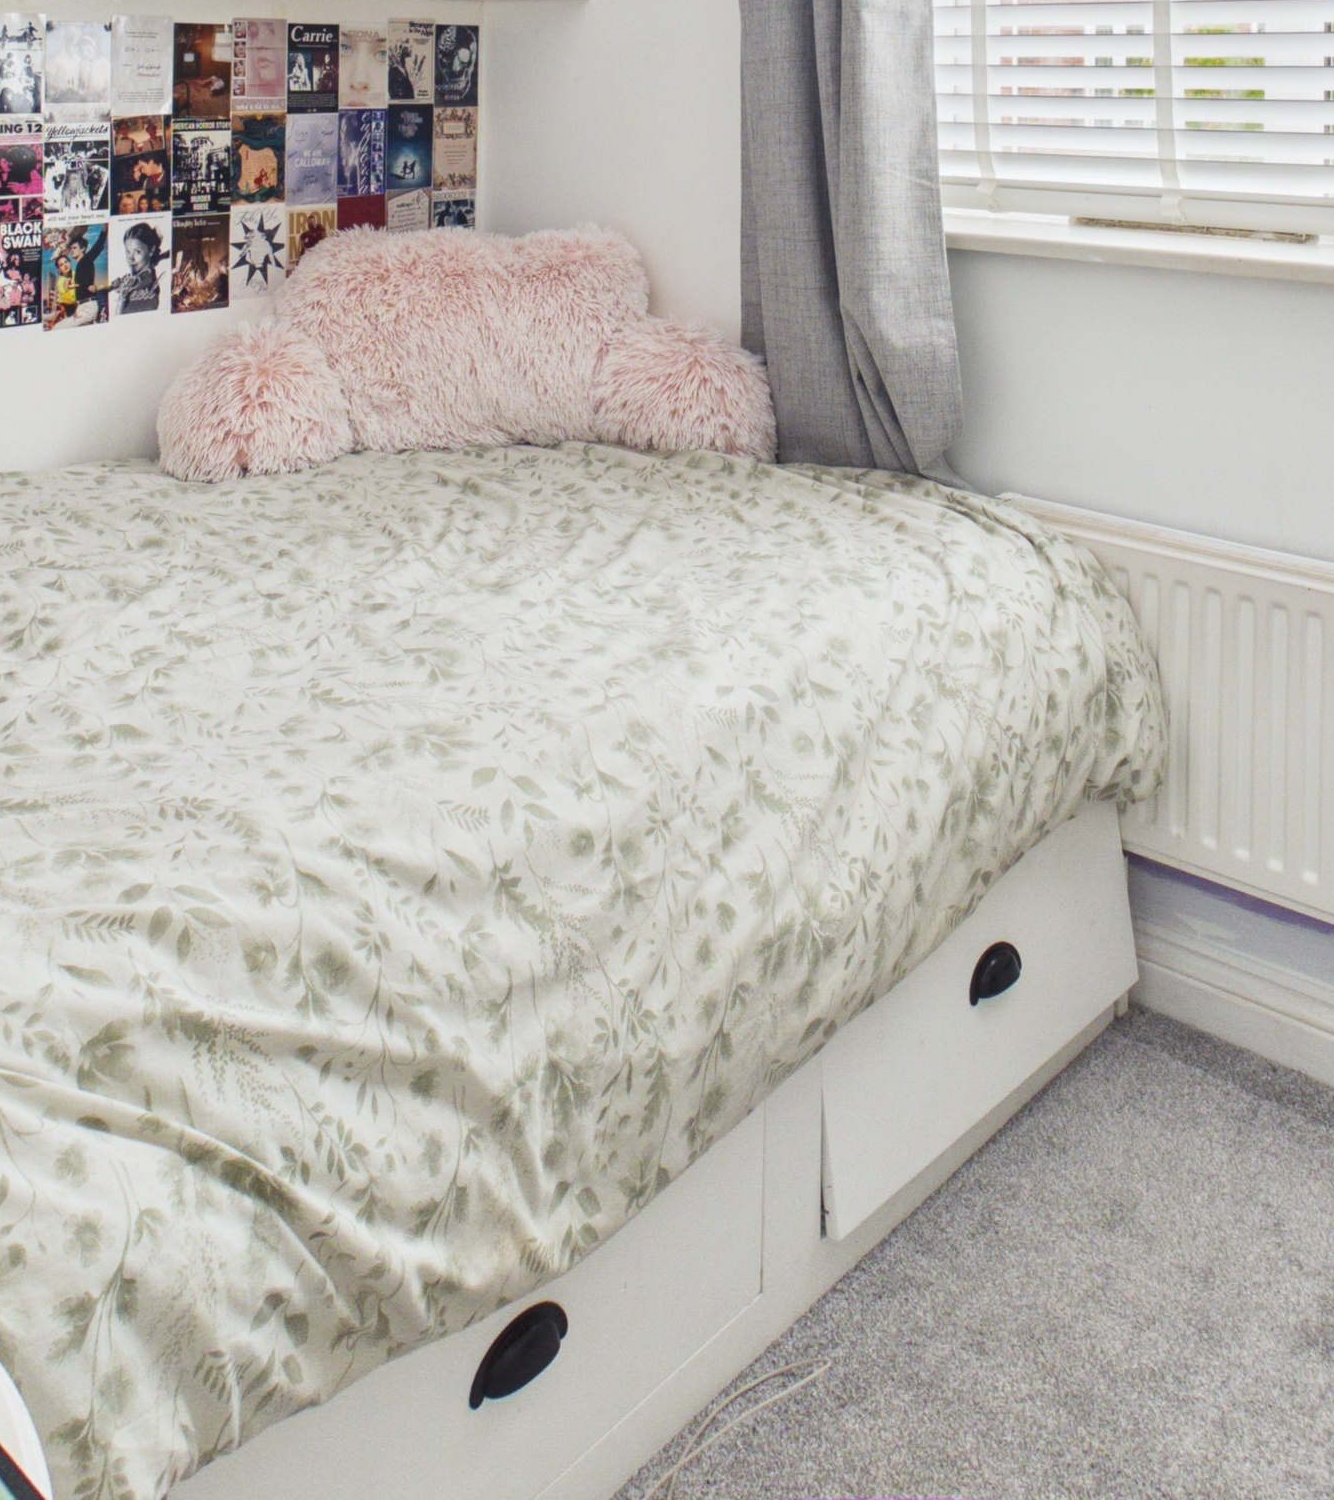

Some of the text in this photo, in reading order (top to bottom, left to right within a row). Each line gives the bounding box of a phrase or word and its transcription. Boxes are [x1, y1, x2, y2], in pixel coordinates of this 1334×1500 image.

[290, 25, 333, 43] Carrie
[26, 122, 43, 133] 12
[46, 124, 109, 141] Yellowjackets
[0, 221, 42, 235] BLACK
[2, 235, 42, 249] SWAN
